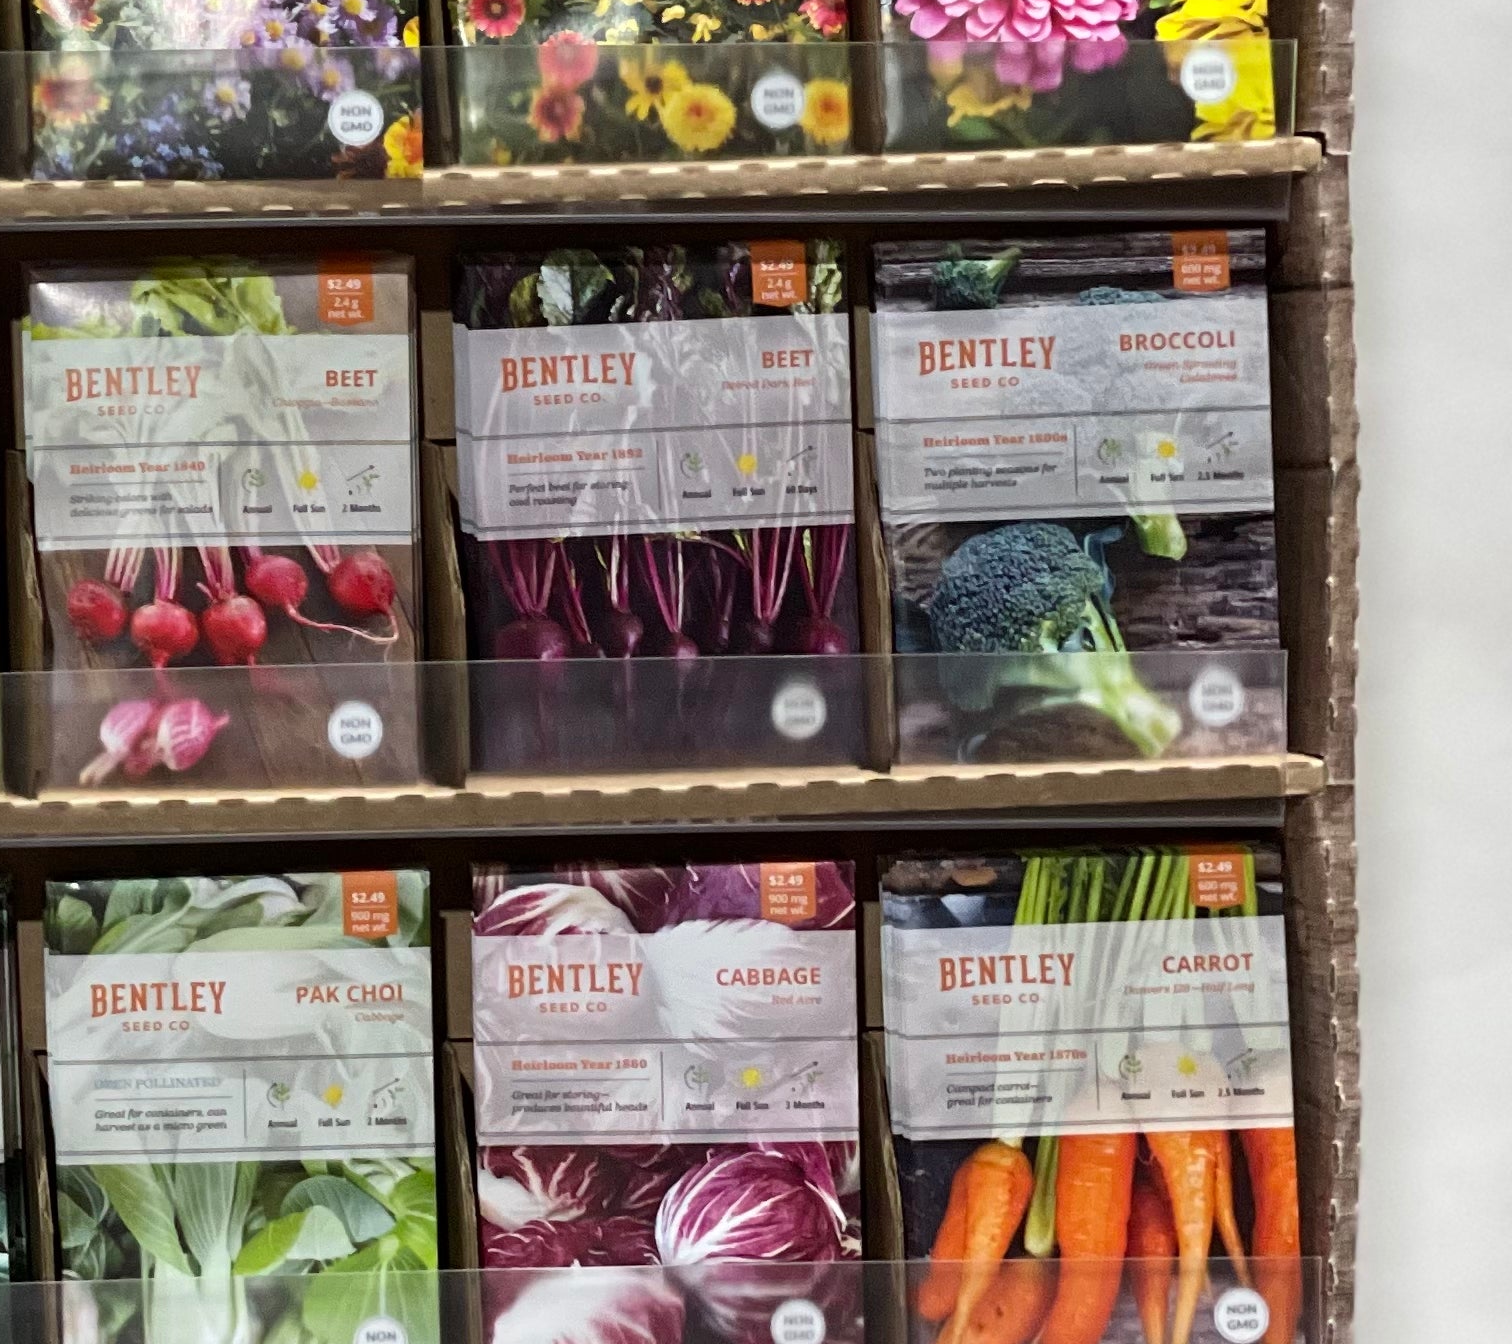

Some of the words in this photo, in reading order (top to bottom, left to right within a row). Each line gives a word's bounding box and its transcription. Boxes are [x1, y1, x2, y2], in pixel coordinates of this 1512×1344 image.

[327, 279, 361, 289] $2.49
[1119, 331, 1235, 352] BROCCOLI
[762, 349, 813, 368] BEET
[919, 336, 1055, 375] BENTLEY
[326, 370, 377, 387] BEET
[501, 353, 635, 392] BENTLEY
[66, 365, 201, 402] BENTLEY
[534, 394, 573, 406] SEED
[1198, 862, 1232, 873] $2.49
[769, 875, 803, 886] $2.49
[352, 892, 385, 903] $2.49
[939, 953, 1074, 991] BENTLEY
[1162, 953, 1252, 973] CARROT
[508, 963, 643, 999] BENTLEY
[716, 966, 820, 986] CABBAGE
[91, 982, 225, 1018] BENTLEY
[295, 984, 341, 1003] PAK
[347, 983, 403, 1003] CHOI
